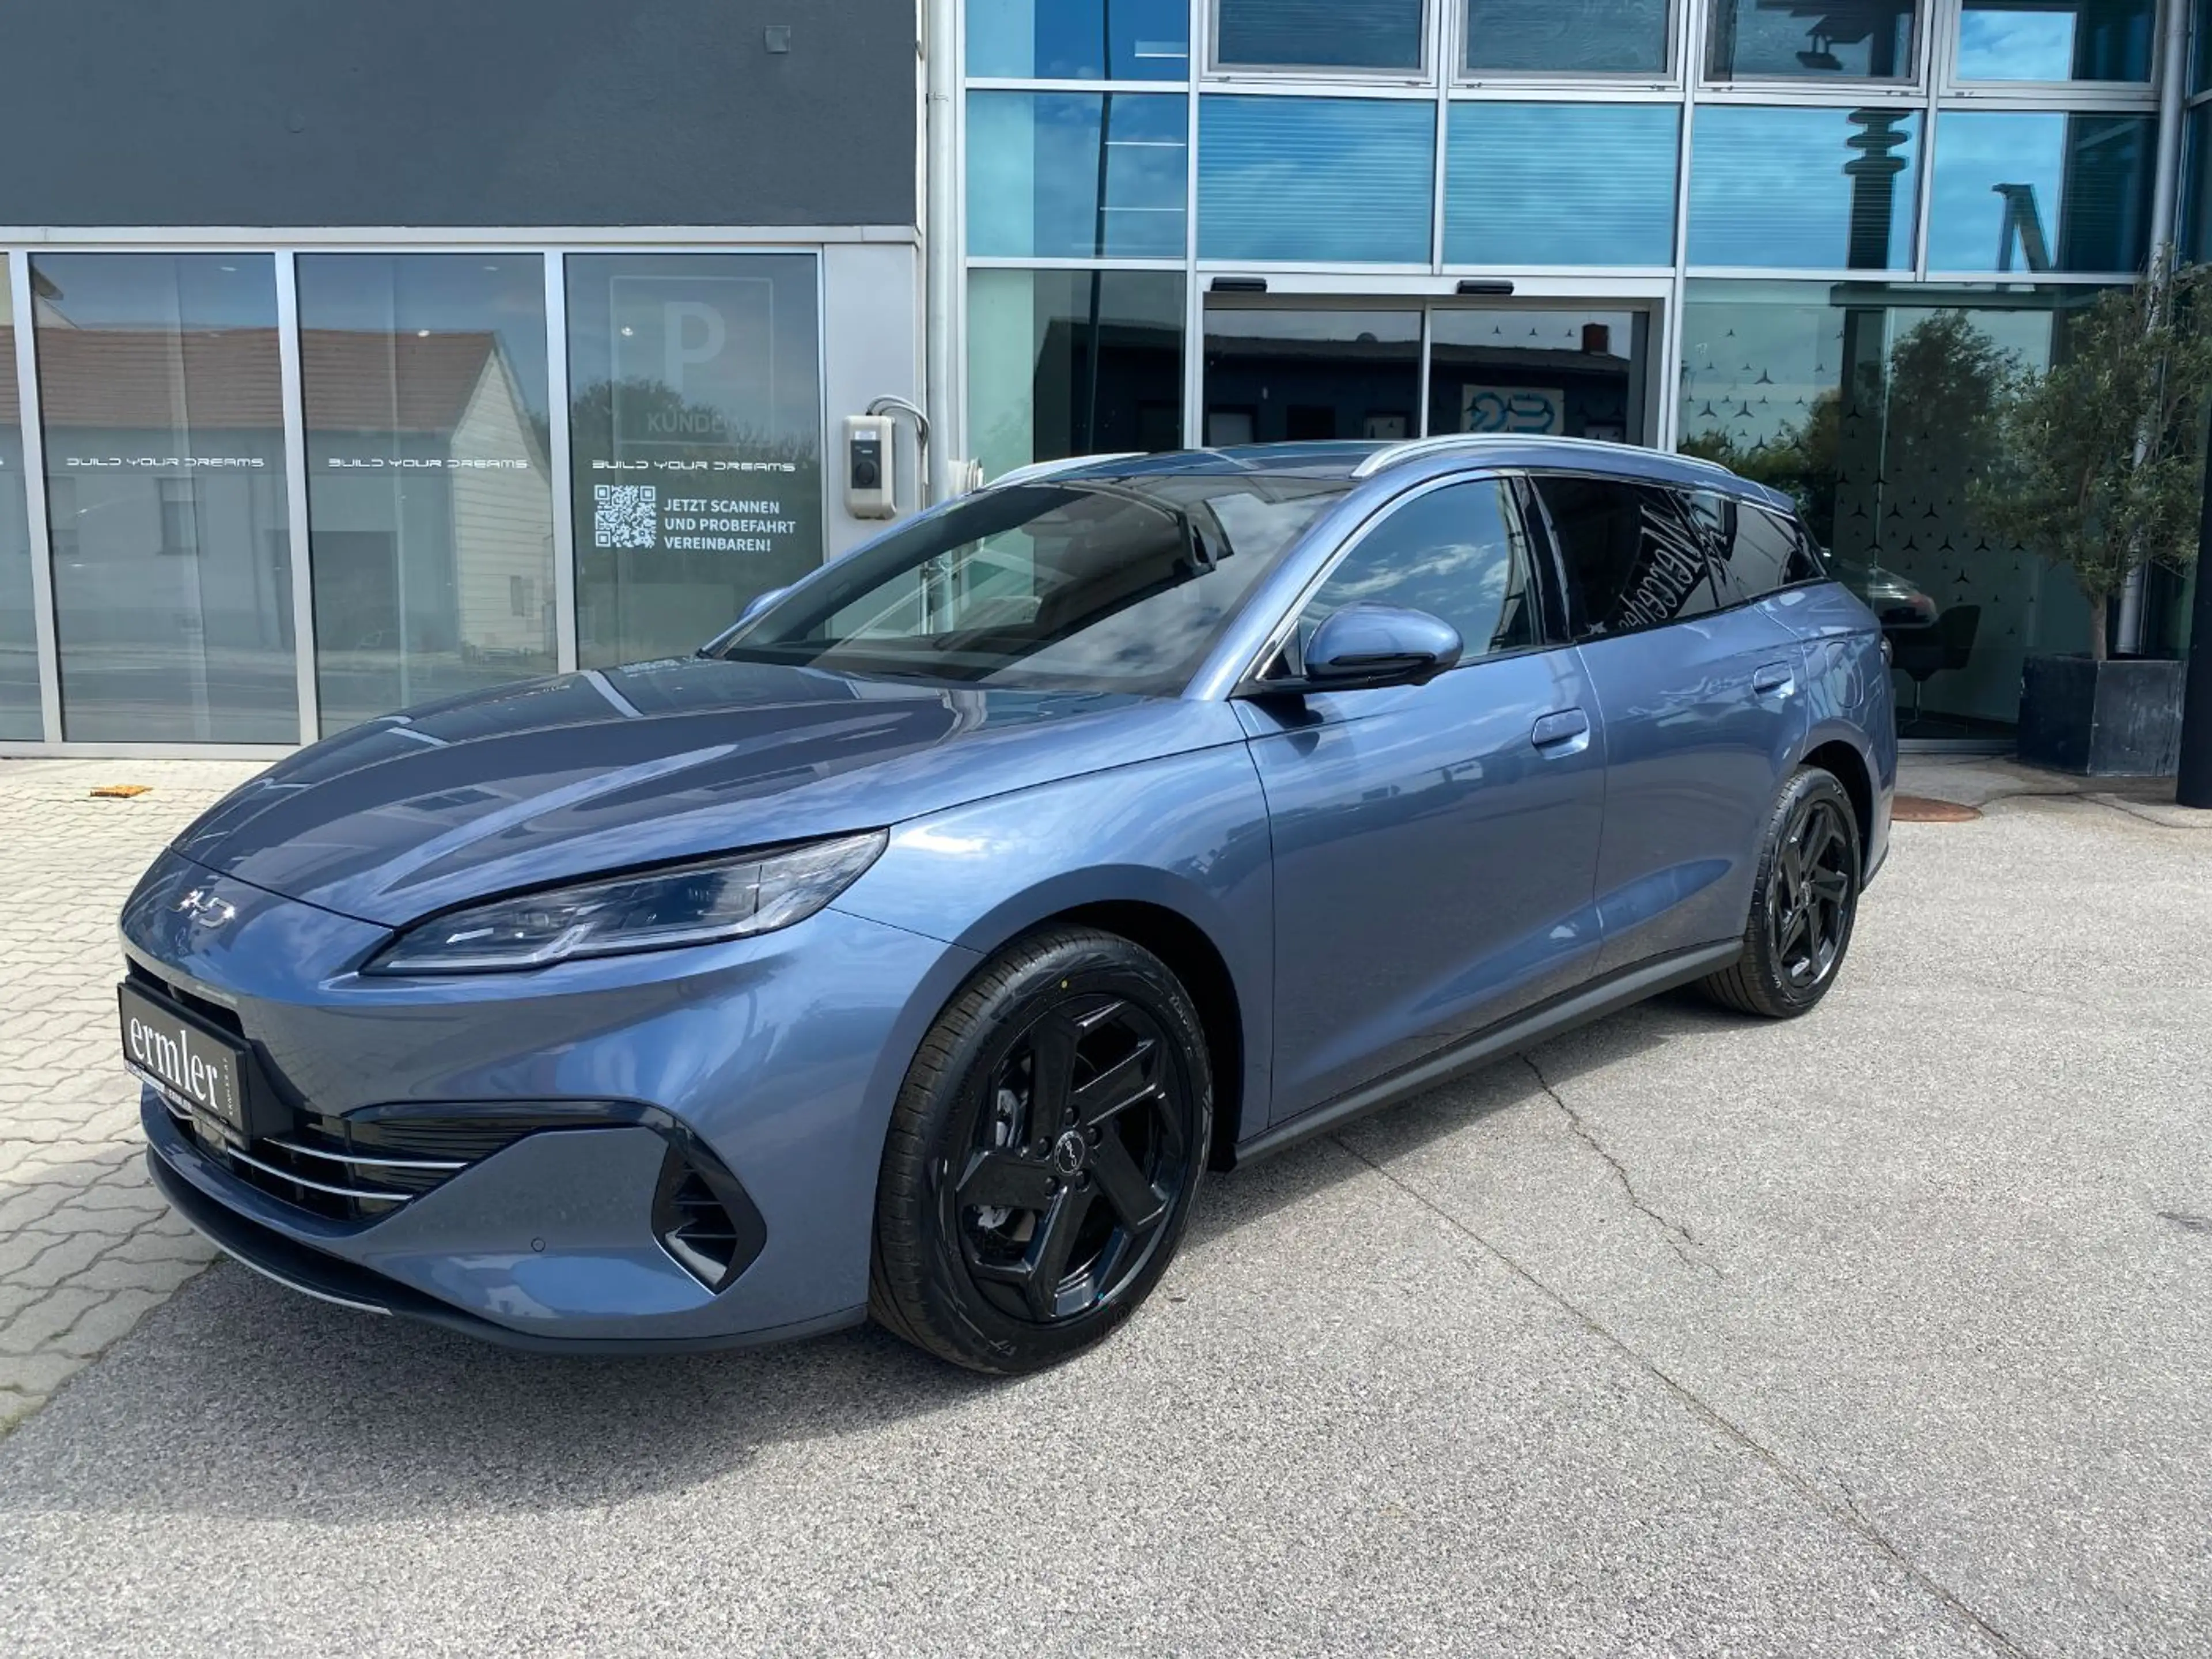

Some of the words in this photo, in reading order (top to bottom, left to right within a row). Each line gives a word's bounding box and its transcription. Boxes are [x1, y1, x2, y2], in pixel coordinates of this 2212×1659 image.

[664, 301, 725, 393] P
[66, 458, 122, 466] BUILD
[126, 458, 179, 467] YOUR
[184, 458, 265, 468] DREAMS
[328, 458, 384, 467] BUILD
[389, 459, 442, 468] YOUR
[447, 459, 528, 468] DREAMS
[592, 460, 649, 469] BUILD
[654, 461, 709, 470] YOUR
[713, 462, 796, 472] DREAMS
[663, 499, 707, 512] JETZT
[710, 499, 780, 514] SCANNEN
[664, 518, 696, 531] UND
[699, 518, 796, 533] PROBEFAHRT
[664, 536, 771, 552] VEREINBAREN!
[130, 1017, 218, 1112] ermler
